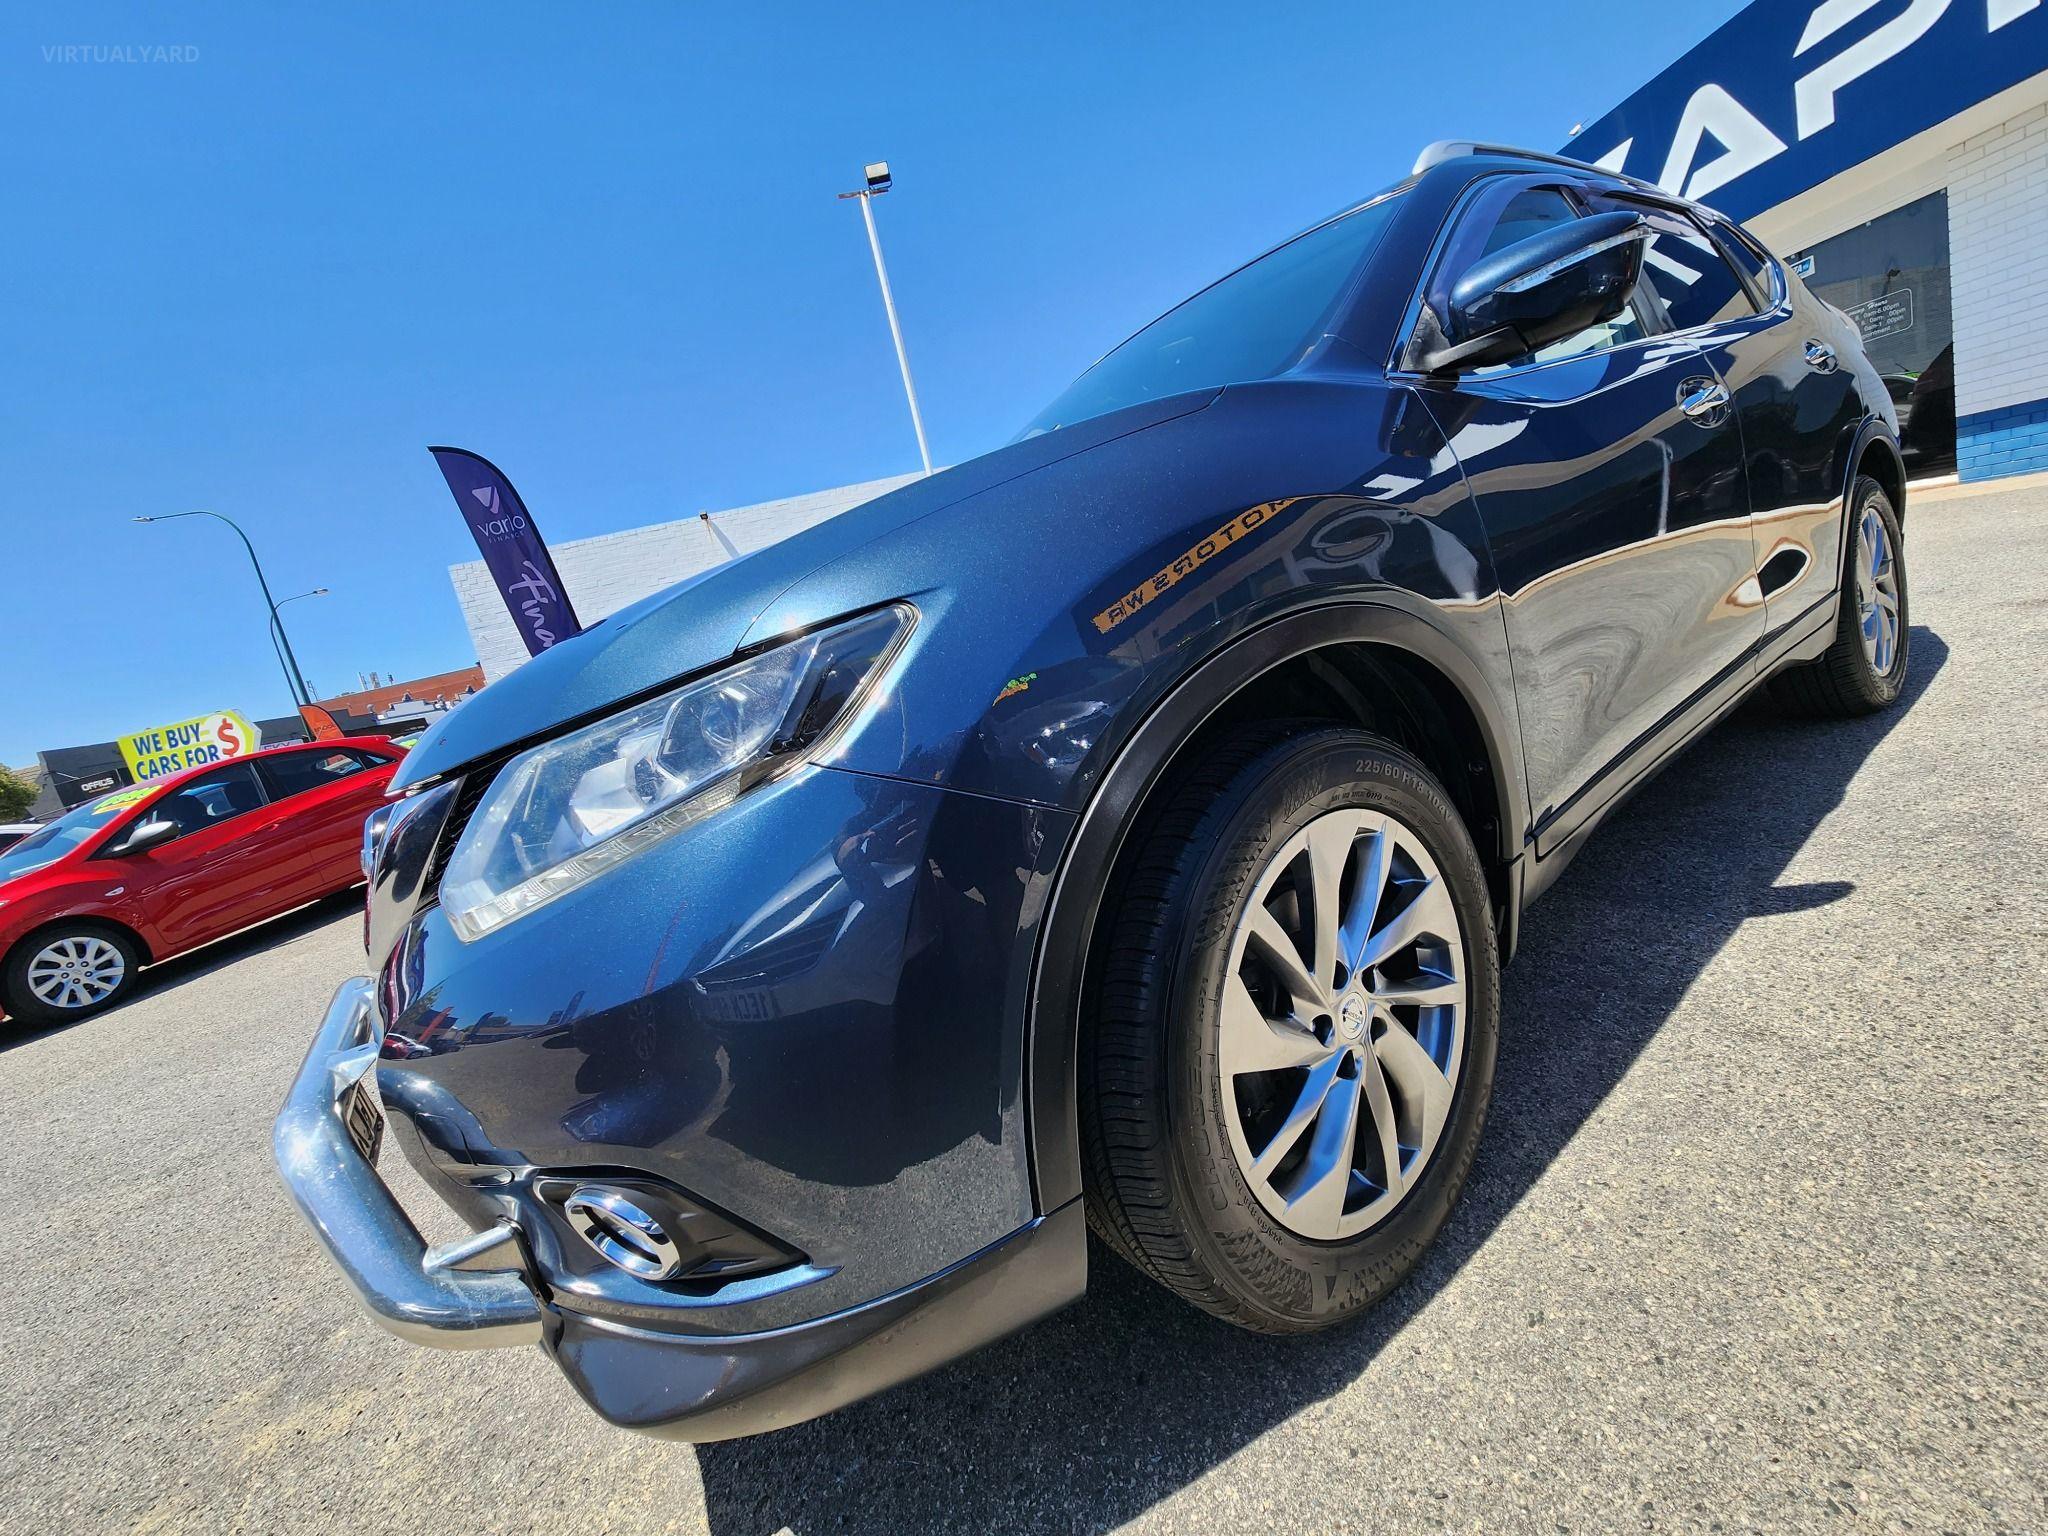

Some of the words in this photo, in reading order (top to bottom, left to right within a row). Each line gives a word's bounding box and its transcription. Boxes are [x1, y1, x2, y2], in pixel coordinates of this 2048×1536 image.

[132, 731, 163, 756] WE
[166, 722, 202, 747] BUY
[217, 718, 241, 757] $
[135, 752, 183, 780] CARS
[185, 744, 220, 768] FOR
[1356, 759, 1400, 779] 225/60
[1402, 771, 1424, 793] R18
